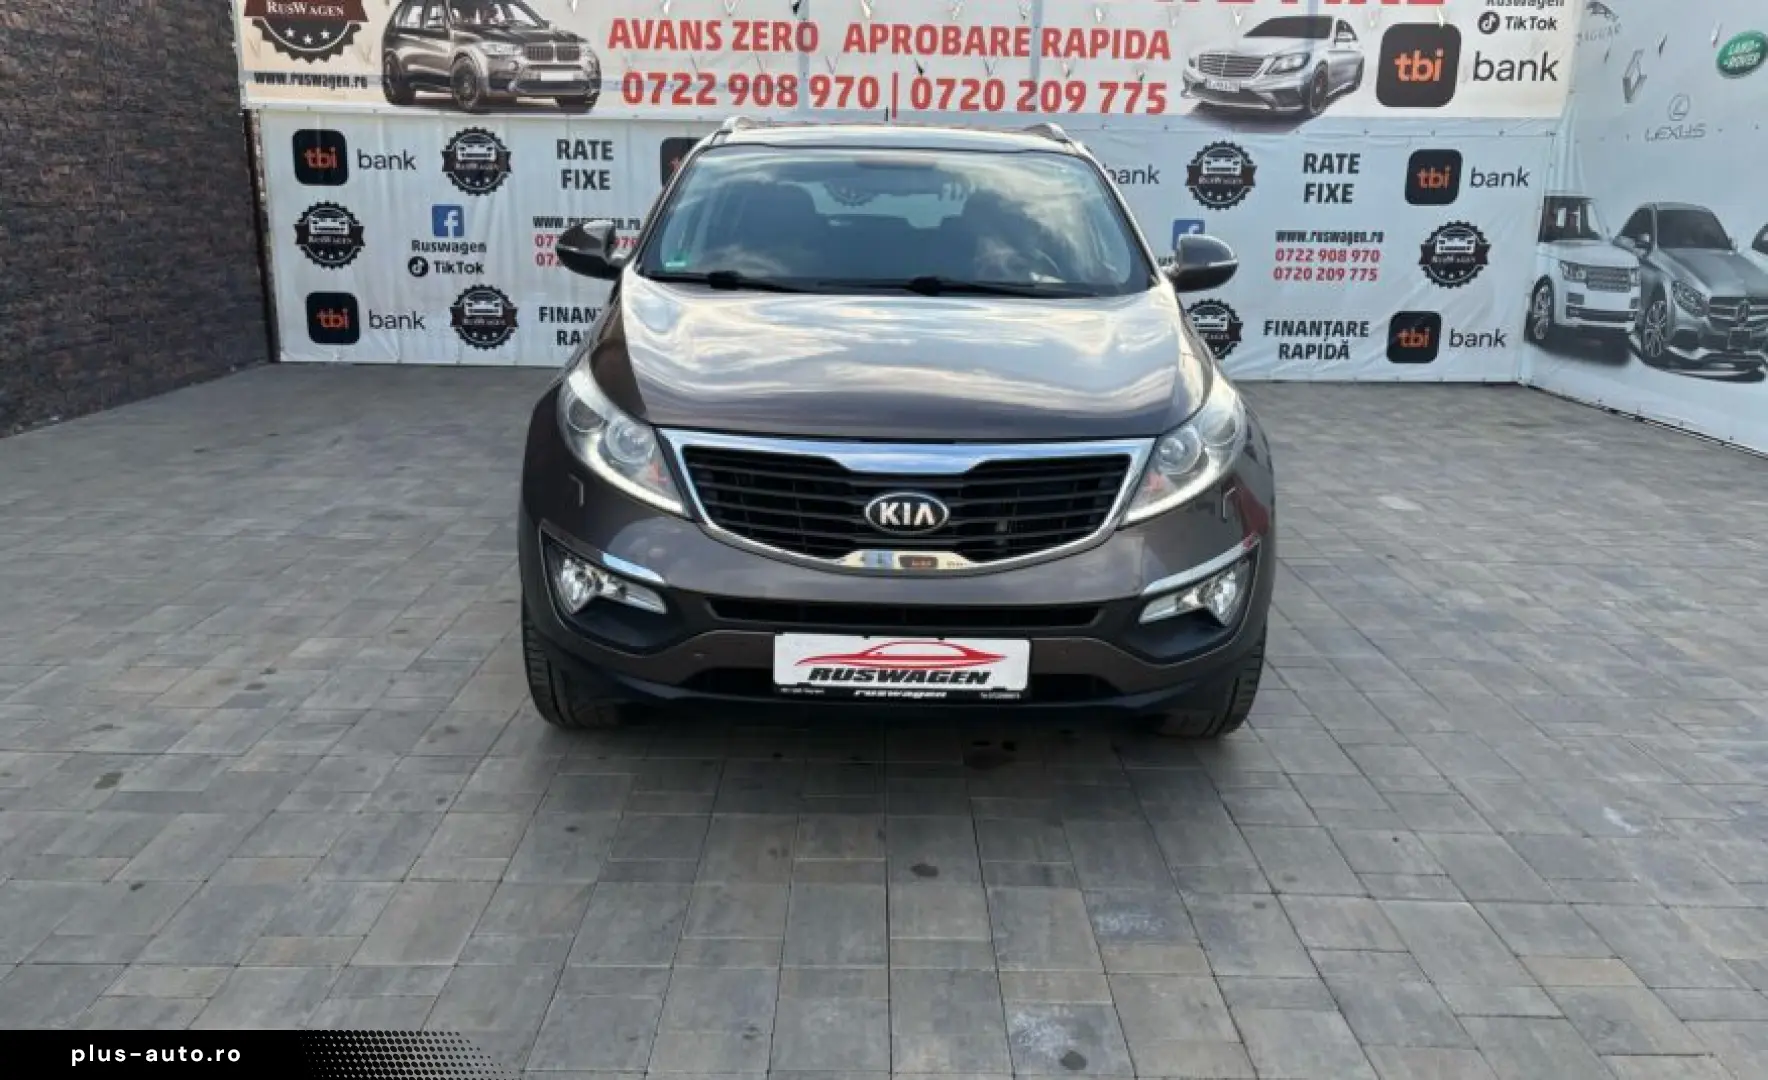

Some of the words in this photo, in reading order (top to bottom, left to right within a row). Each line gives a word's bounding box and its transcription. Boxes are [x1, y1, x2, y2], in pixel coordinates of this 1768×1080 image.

[1505, 15, 1557, 31] TikTok
[607, 18, 723, 51] AVANS
[731, 20, 820, 53] ZERO
[843, 23, 1031, 58] APROBARE
[1040, 27, 1171, 60] RAPIDA
[1394, 50, 1445, 82] tbi
[1473, 51, 1559, 82] bank
[622, 71, 717, 106] 0722
[728, 72, 798, 108] 908
[809, 74, 880, 109] 970
[910, 77, 1004, 111] 0720
[1016, 79, 1087, 113] 209
[1098, 81, 1168, 115] 775
[357, 149, 417, 171] bank
[556, 139, 614, 161] RATE
[1303, 152, 1361, 175] RATE
[561, 169, 610, 190] FIXE
[1470, 167, 1530, 189] bank
[1303, 183, 1354, 204] FIXE
[411, 239, 487, 255] Ruswagen
[1275, 248, 1314, 262] 0722
[1319, 248, 1347, 263] 908
[1351, 249, 1381, 263] 970
[433, 260, 485, 275] TikTok
[1273, 267, 1313, 280] 0720
[1316, 267, 1345, 281] 209
[1350, 268, 1378, 281] 775
[368, 310, 426, 330] bank
[1278, 339, 1350, 360] RAPIDĂ
[1449, 329, 1507, 349] bank
[879, 502, 936, 526] KIA
[807, 667, 992, 685] RUSWAGEN
